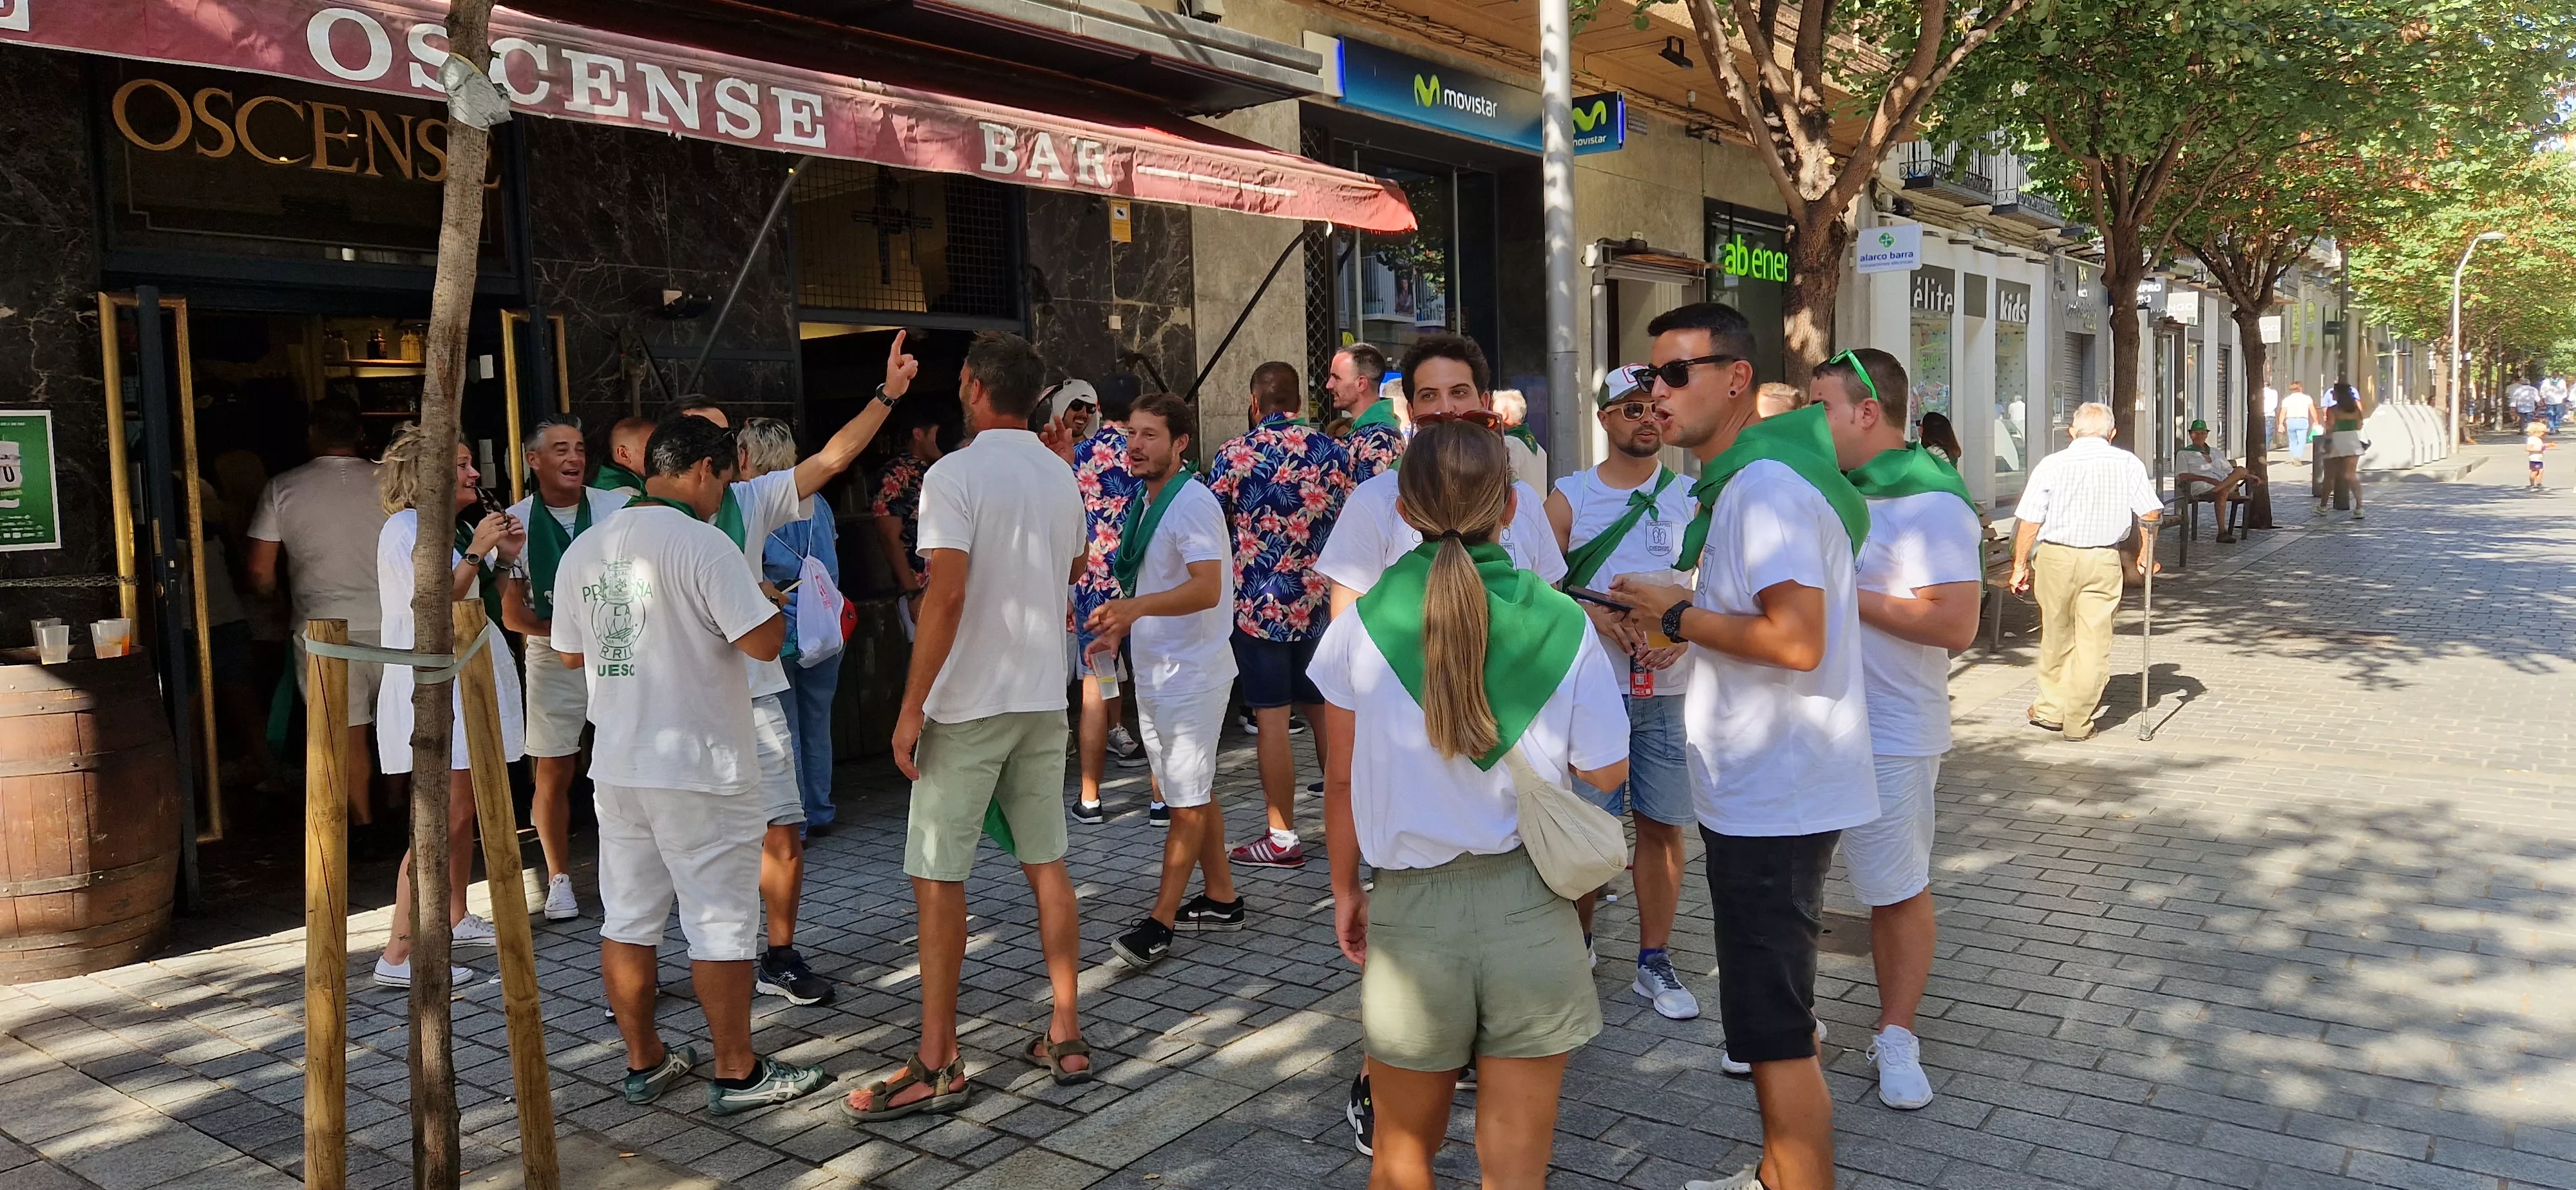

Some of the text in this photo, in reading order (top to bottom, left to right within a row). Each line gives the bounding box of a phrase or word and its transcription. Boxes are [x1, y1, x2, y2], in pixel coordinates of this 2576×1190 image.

[306, 8, 1113, 189] OSCENSE BAR
[1444, 88, 1498, 118] movistar
[112, 79, 501, 189] OSCENS
[1725, 234, 1788, 283] ab ener
[1860, 250, 1914, 262] alarco barra
[2000, 290, 2027, 323] kids
